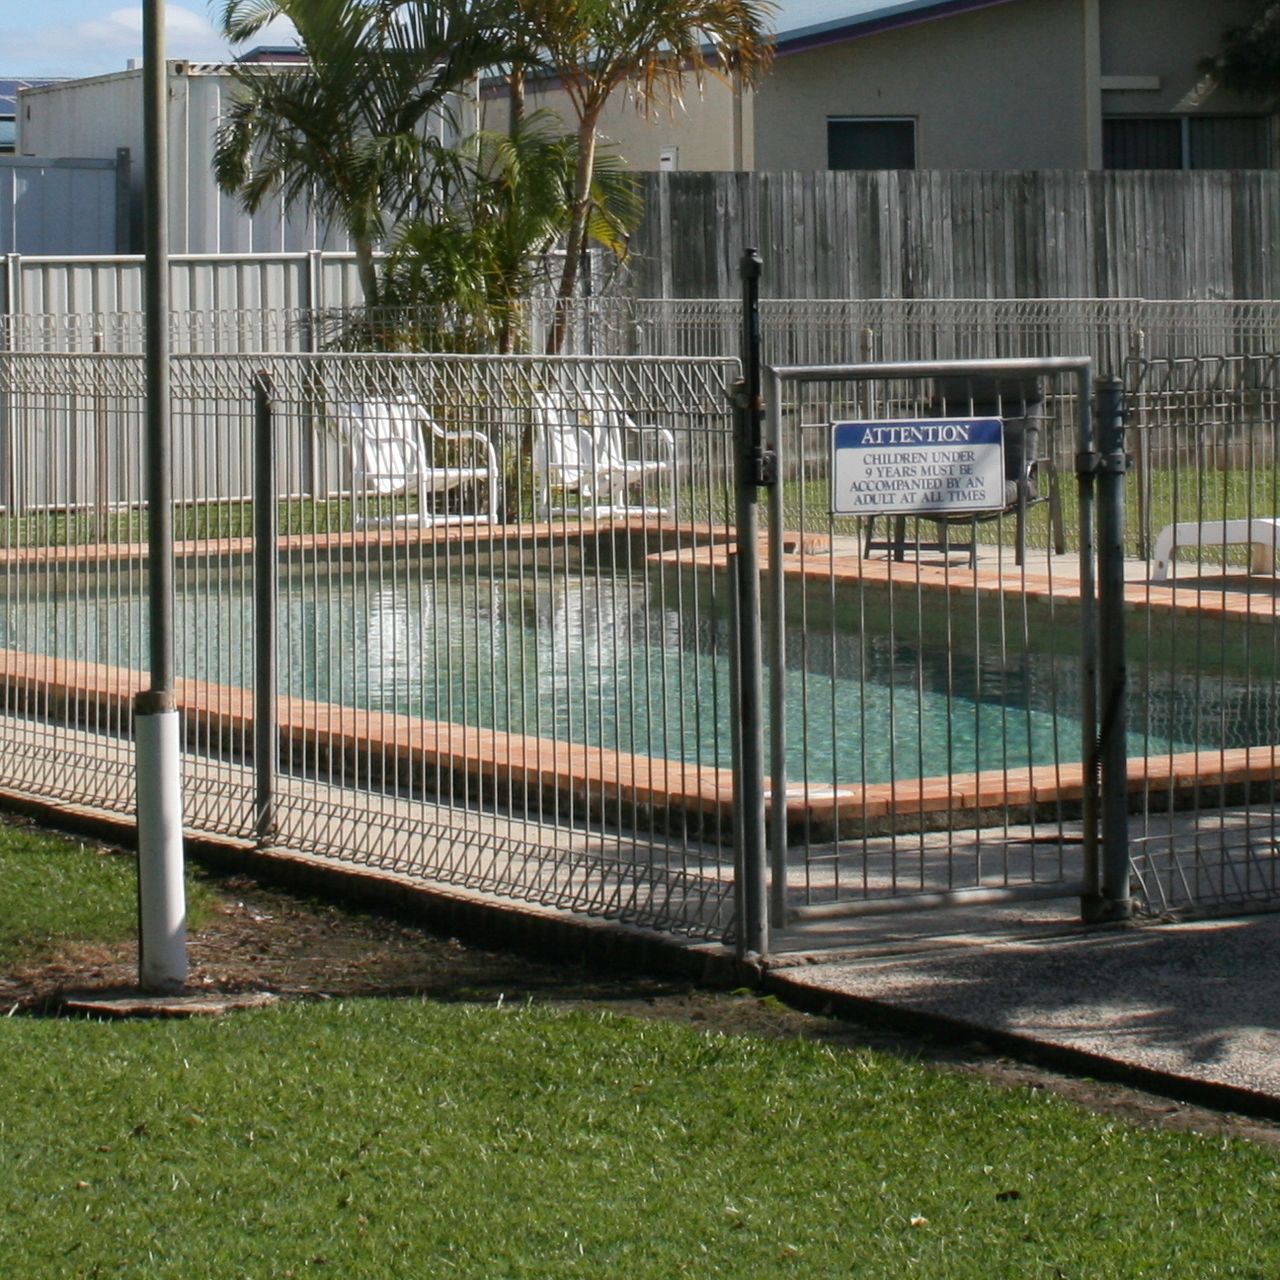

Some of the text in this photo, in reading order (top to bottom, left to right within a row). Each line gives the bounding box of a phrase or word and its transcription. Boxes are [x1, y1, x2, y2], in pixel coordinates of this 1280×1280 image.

[861, 424, 970, 445] ATTENTION
[863, 450, 976, 466] CHILDREN UNDER
[865, 463, 973, 479] 9 YEARS MUST BE
[849, 476, 985, 493] ACCOMPANIED BY AN
[853, 489, 986, 506] ADULT AT ALL TIMES
